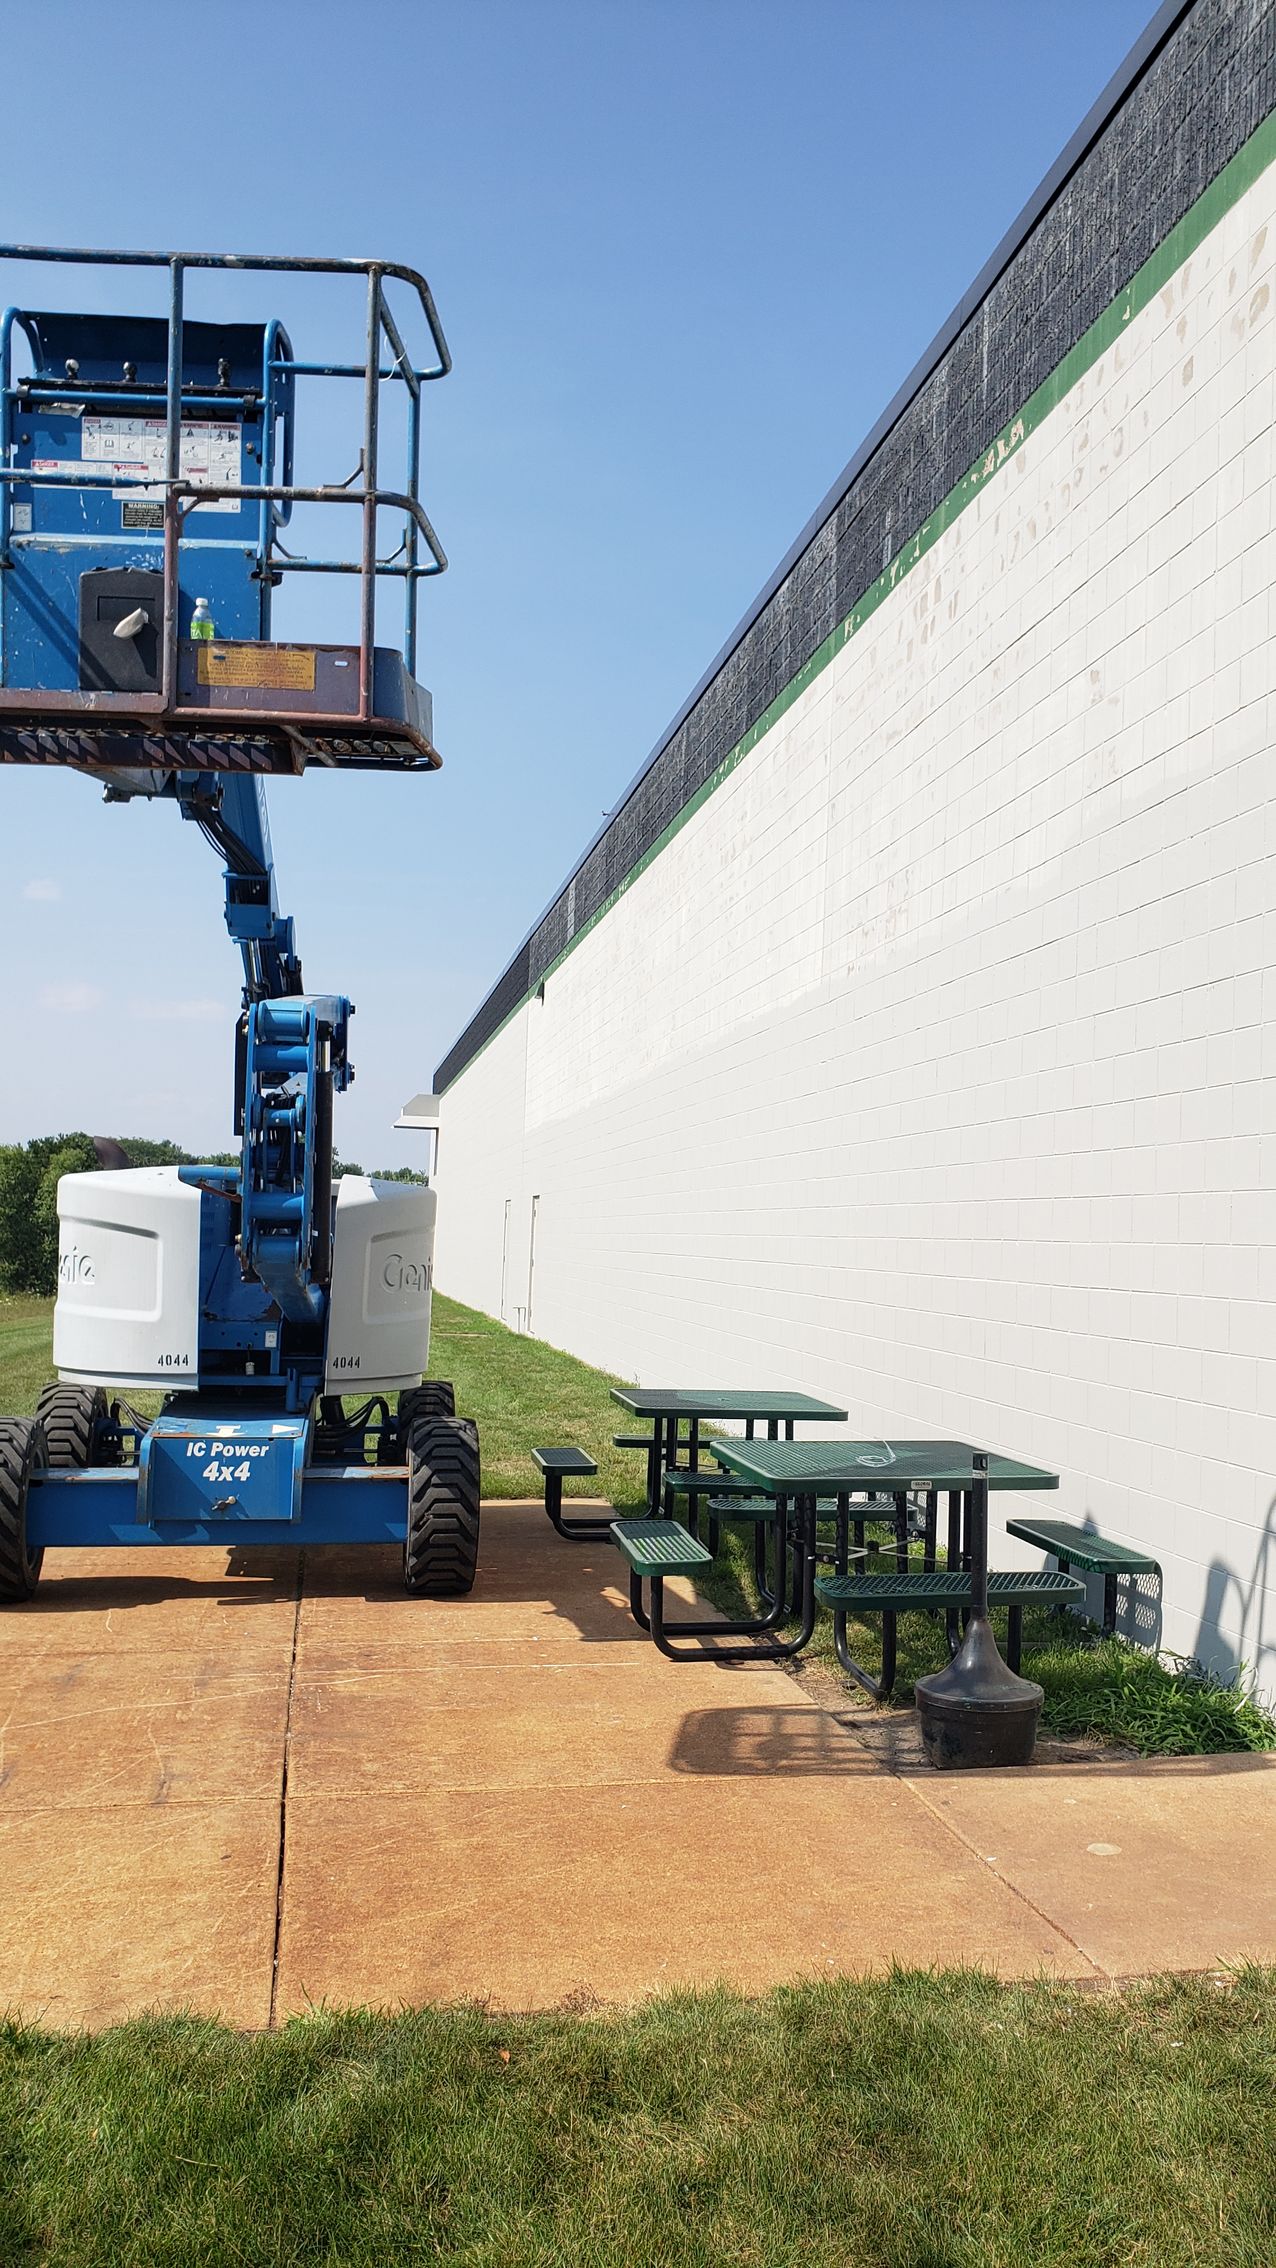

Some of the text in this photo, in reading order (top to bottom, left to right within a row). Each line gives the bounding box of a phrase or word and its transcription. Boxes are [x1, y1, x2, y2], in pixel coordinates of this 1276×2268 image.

[383, 1253, 433, 1292] Geni
[157, 1354, 189, 1367] 4044
[332, 1356, 361, 1369] 4044
[186, 1442, 270, 1457] IC Power
[202, 1461, 251, 1482] 4x4
